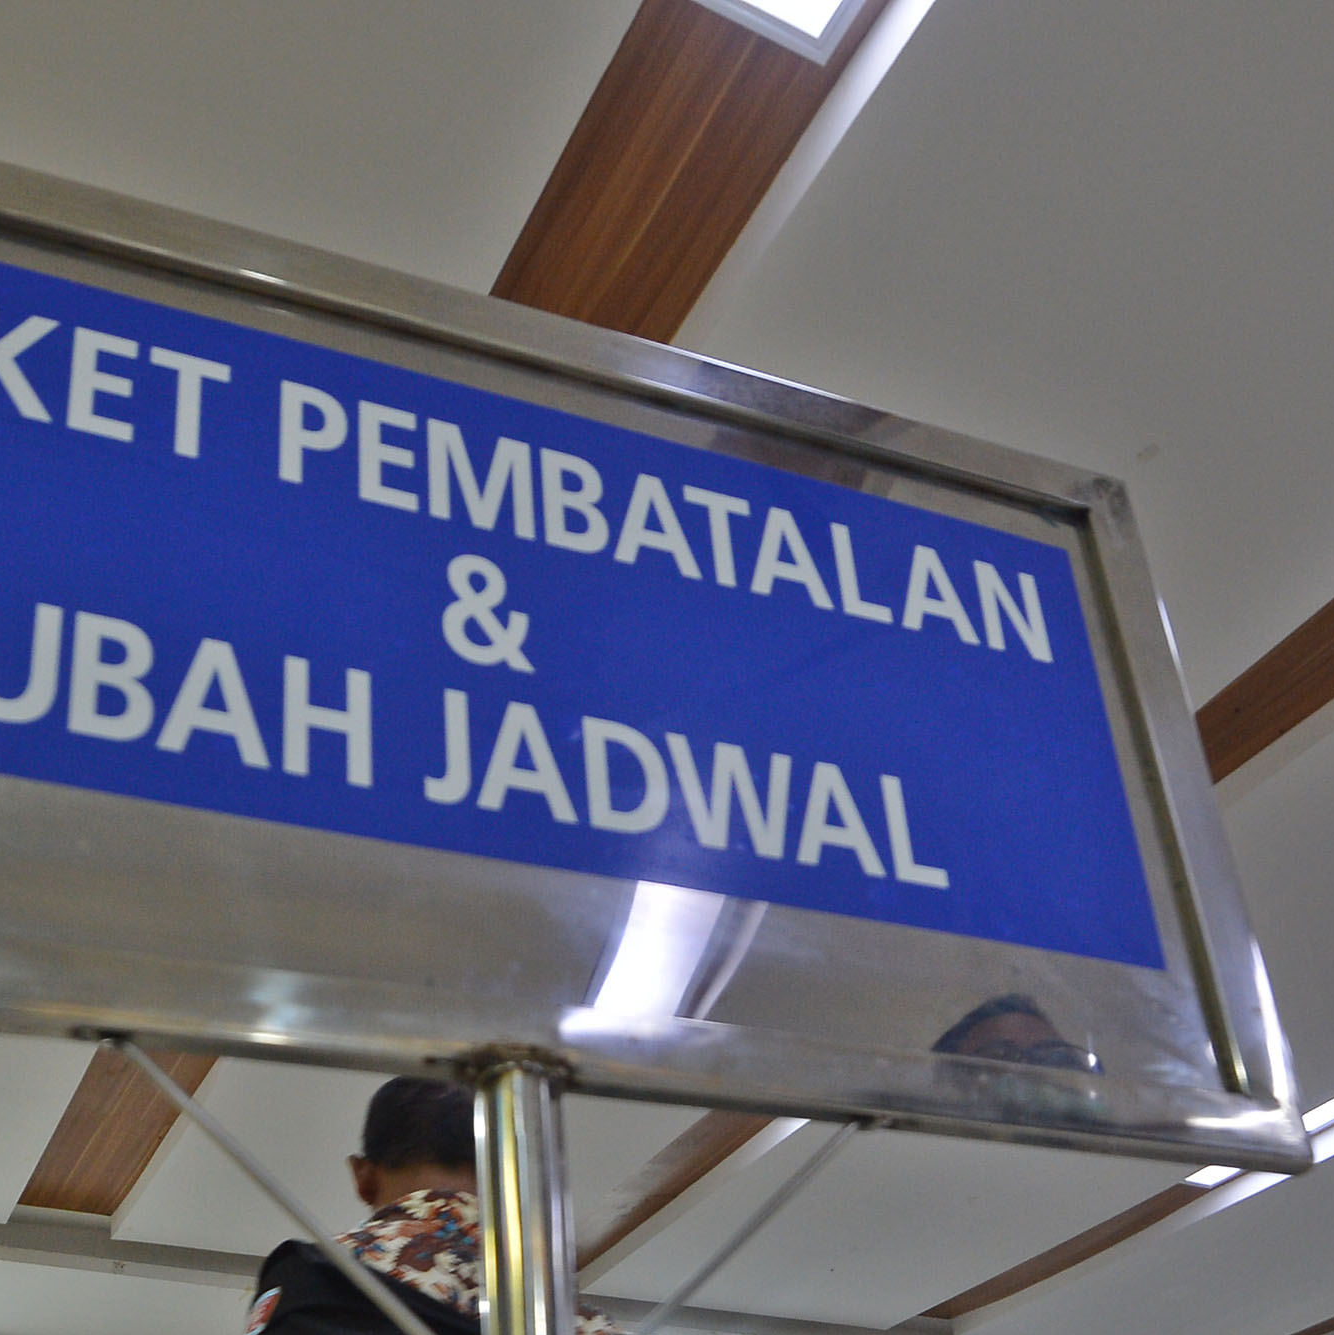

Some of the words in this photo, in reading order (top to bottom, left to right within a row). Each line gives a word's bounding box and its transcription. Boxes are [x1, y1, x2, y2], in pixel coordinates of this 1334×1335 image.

[278, 380, 1054, 664] PEMBATALAN
[442, 554, 535, 672] &
[424, 688, 950, 889] JADWAL
